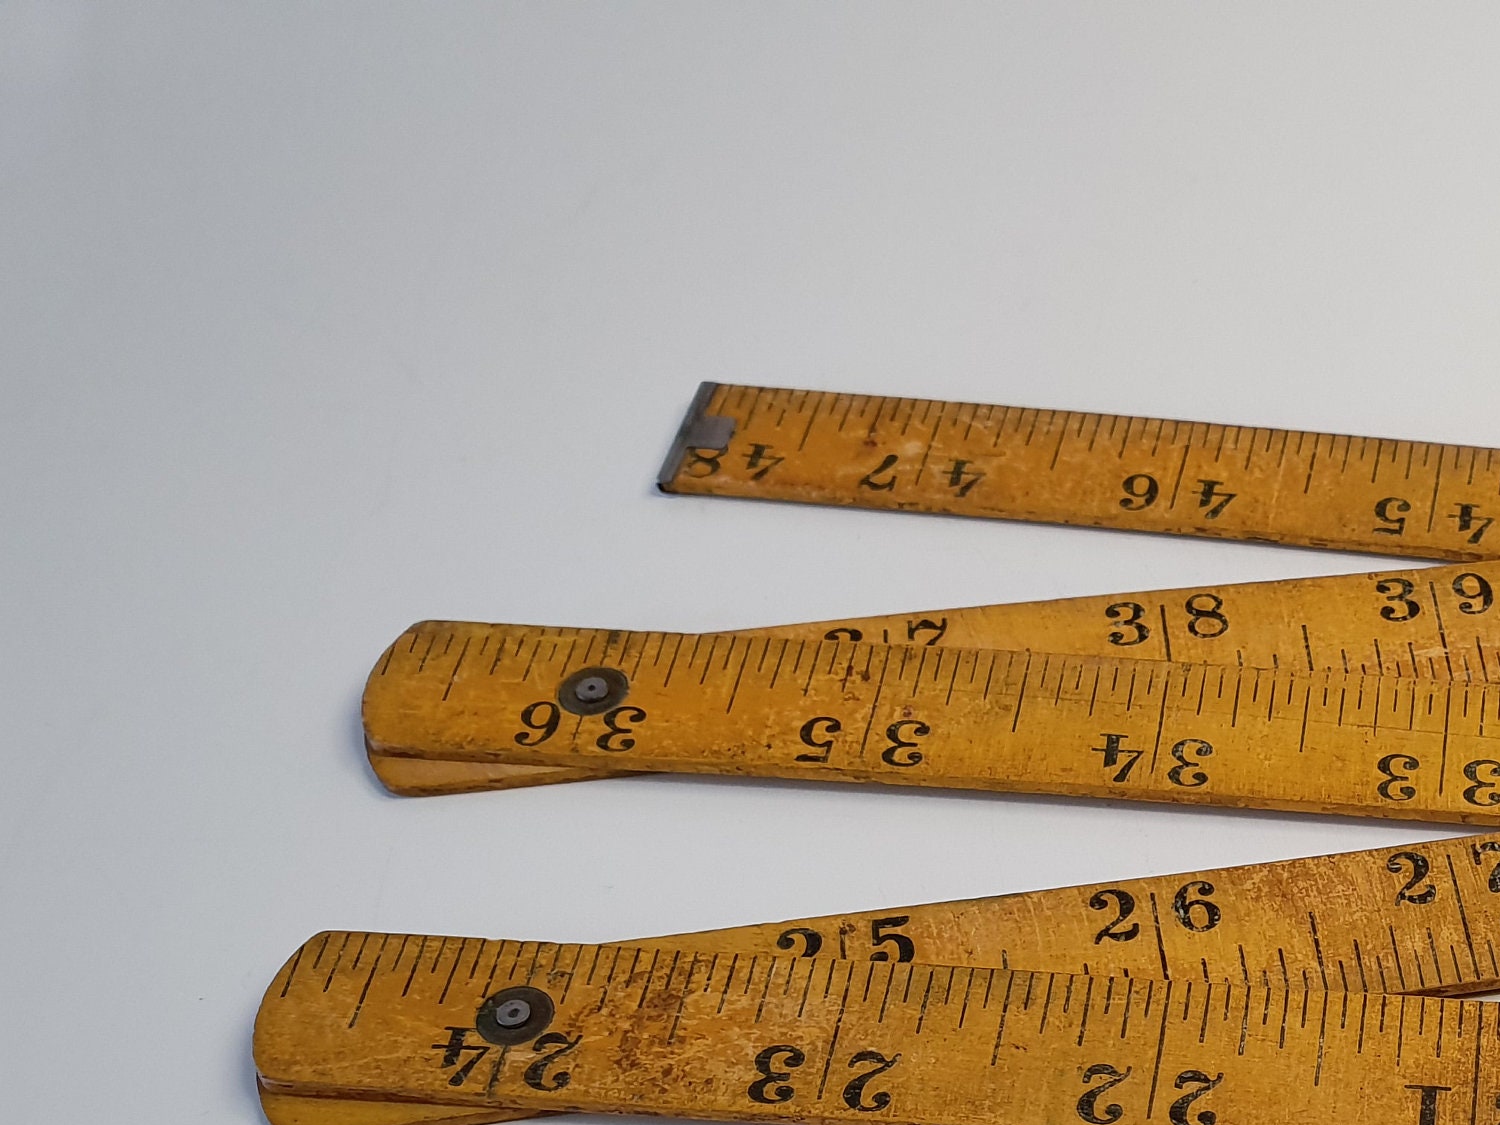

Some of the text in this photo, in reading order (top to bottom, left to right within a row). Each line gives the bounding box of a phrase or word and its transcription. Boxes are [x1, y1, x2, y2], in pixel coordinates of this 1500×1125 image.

[685, 443, 785, 480] 48
[861, 454, 986, 497] 47
[1119, 474, 1237, 519] 46
[1373, 497, 1495, 545] 45
[1106, 593, 1229, 646] 38
[1376, 573, 1493, 621] 39
[514, 701, 647, 752] 36
[794, 716, 930, 766] 35
[1091, 733, 1214, 786] 34
[1089, 881, 1222, 945] 26
[431, 1027, 583, 1092] 24
[747, 1044, 901, 1111] 23
